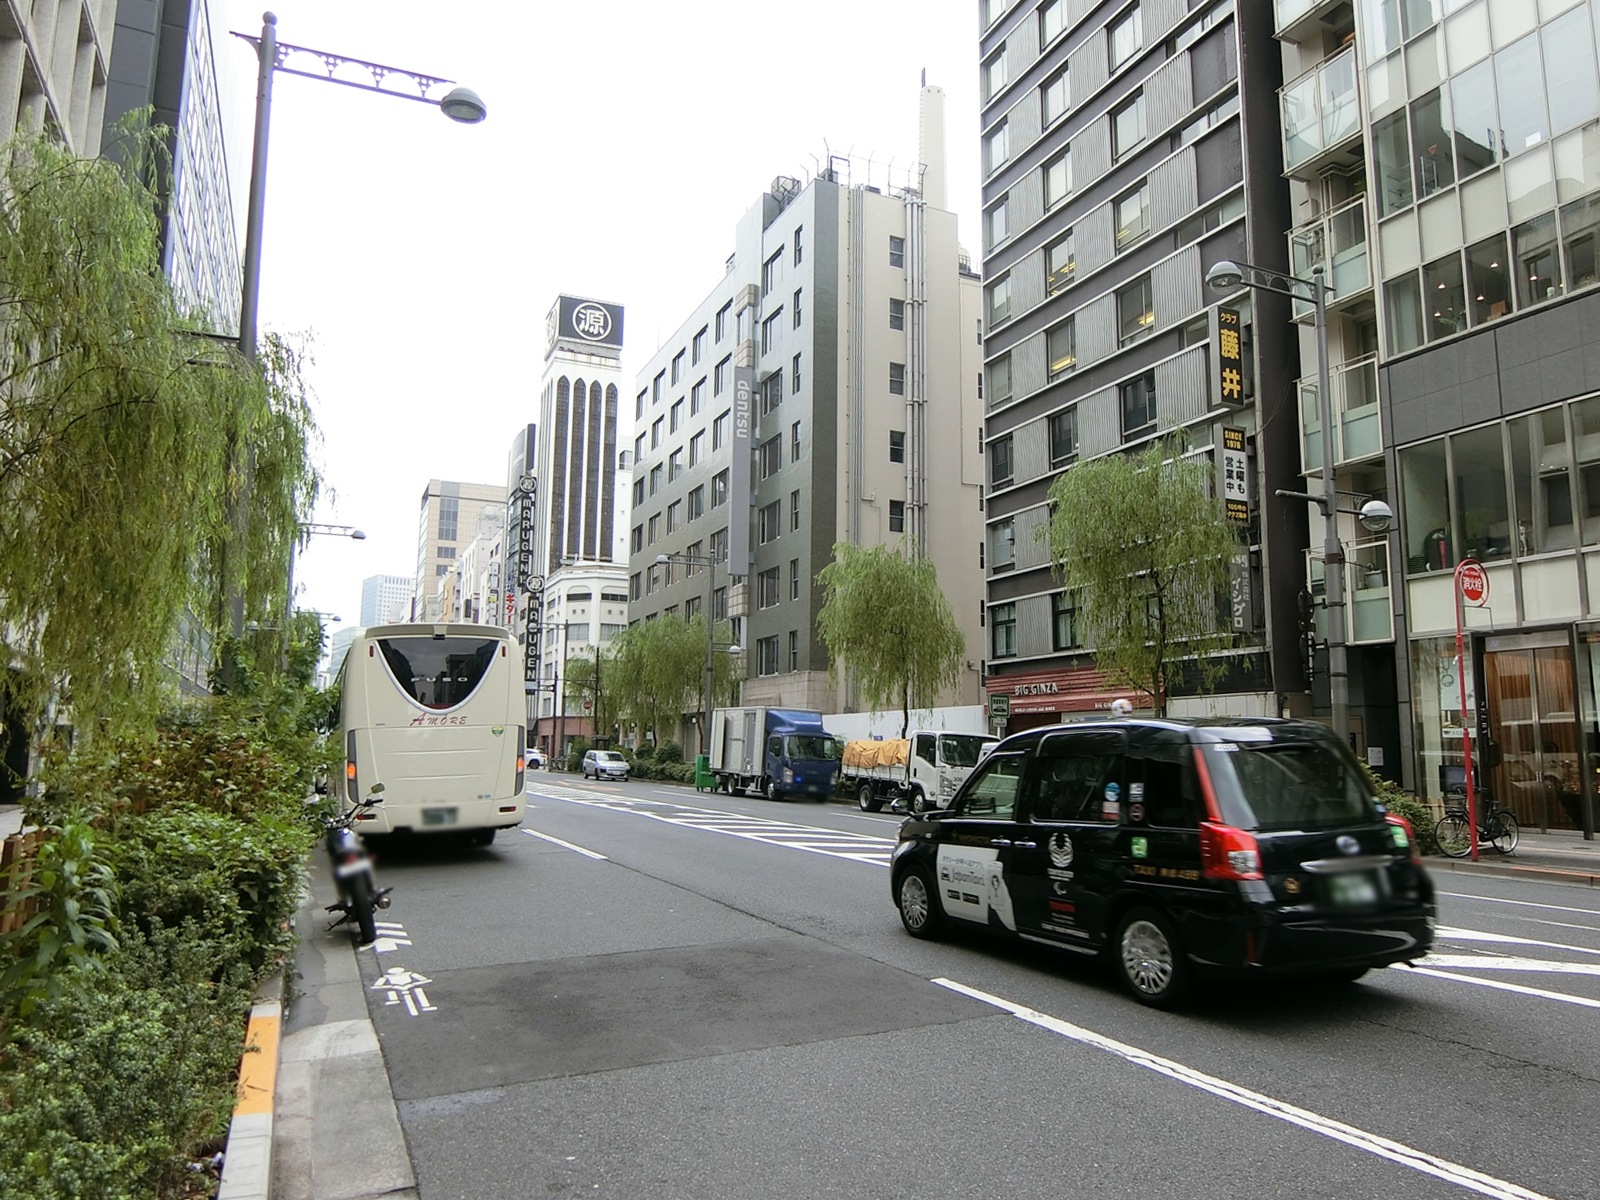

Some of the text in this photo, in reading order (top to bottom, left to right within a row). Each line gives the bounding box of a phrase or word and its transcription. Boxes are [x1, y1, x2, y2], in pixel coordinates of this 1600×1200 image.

[578, 308, 605, 335] 源
[1220, 312, 1238, 324] クラブ
[1220, 328, 1240, 398] 藤井
[736, 379, 750, 438] dentsu
[1224, 430, 1242, 441] SINCE
[1225, 456, 1235, 492] 営業中
[1235, 459, 1245, 494] 土曜も
[519, 498, 533, 572] MARUGEN
[1462, 576, 1483, 592] 消火栓
[1232, 577, 1246, 627] イシグロ
[527, 599, 539, 679] MAUGEN
[1031, 682, 1058, 695] GINZA
